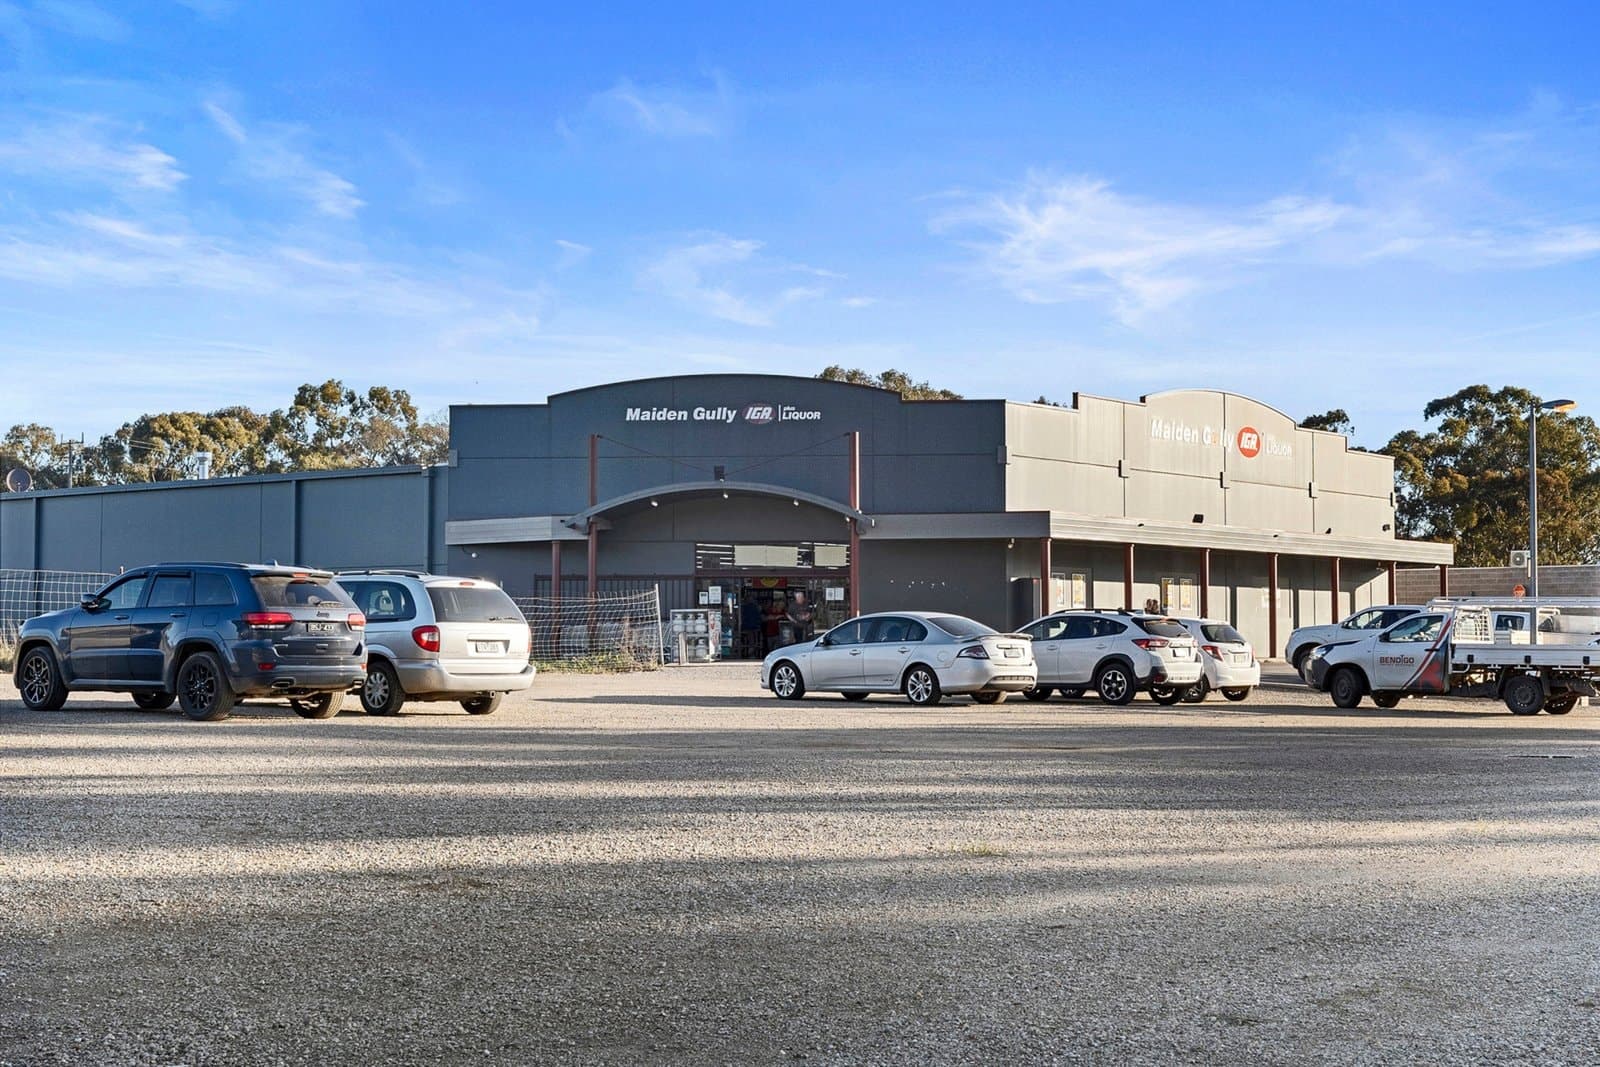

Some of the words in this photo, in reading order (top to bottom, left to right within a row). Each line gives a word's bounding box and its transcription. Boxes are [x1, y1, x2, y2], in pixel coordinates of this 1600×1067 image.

[626, 408, 688, 421] Maiden
[693, 407, 737, 423] Gully
[745, 407, 772, 420] IGA
[782, 411, 822, 420] LIQUOR
[1152, 419, 1198, 442] Maiden
[1203, 424, 1234, 452] Glly
[1240, 431, 1258, 450] IGA
[1379, 654, 1415, 664] BENDIGO
